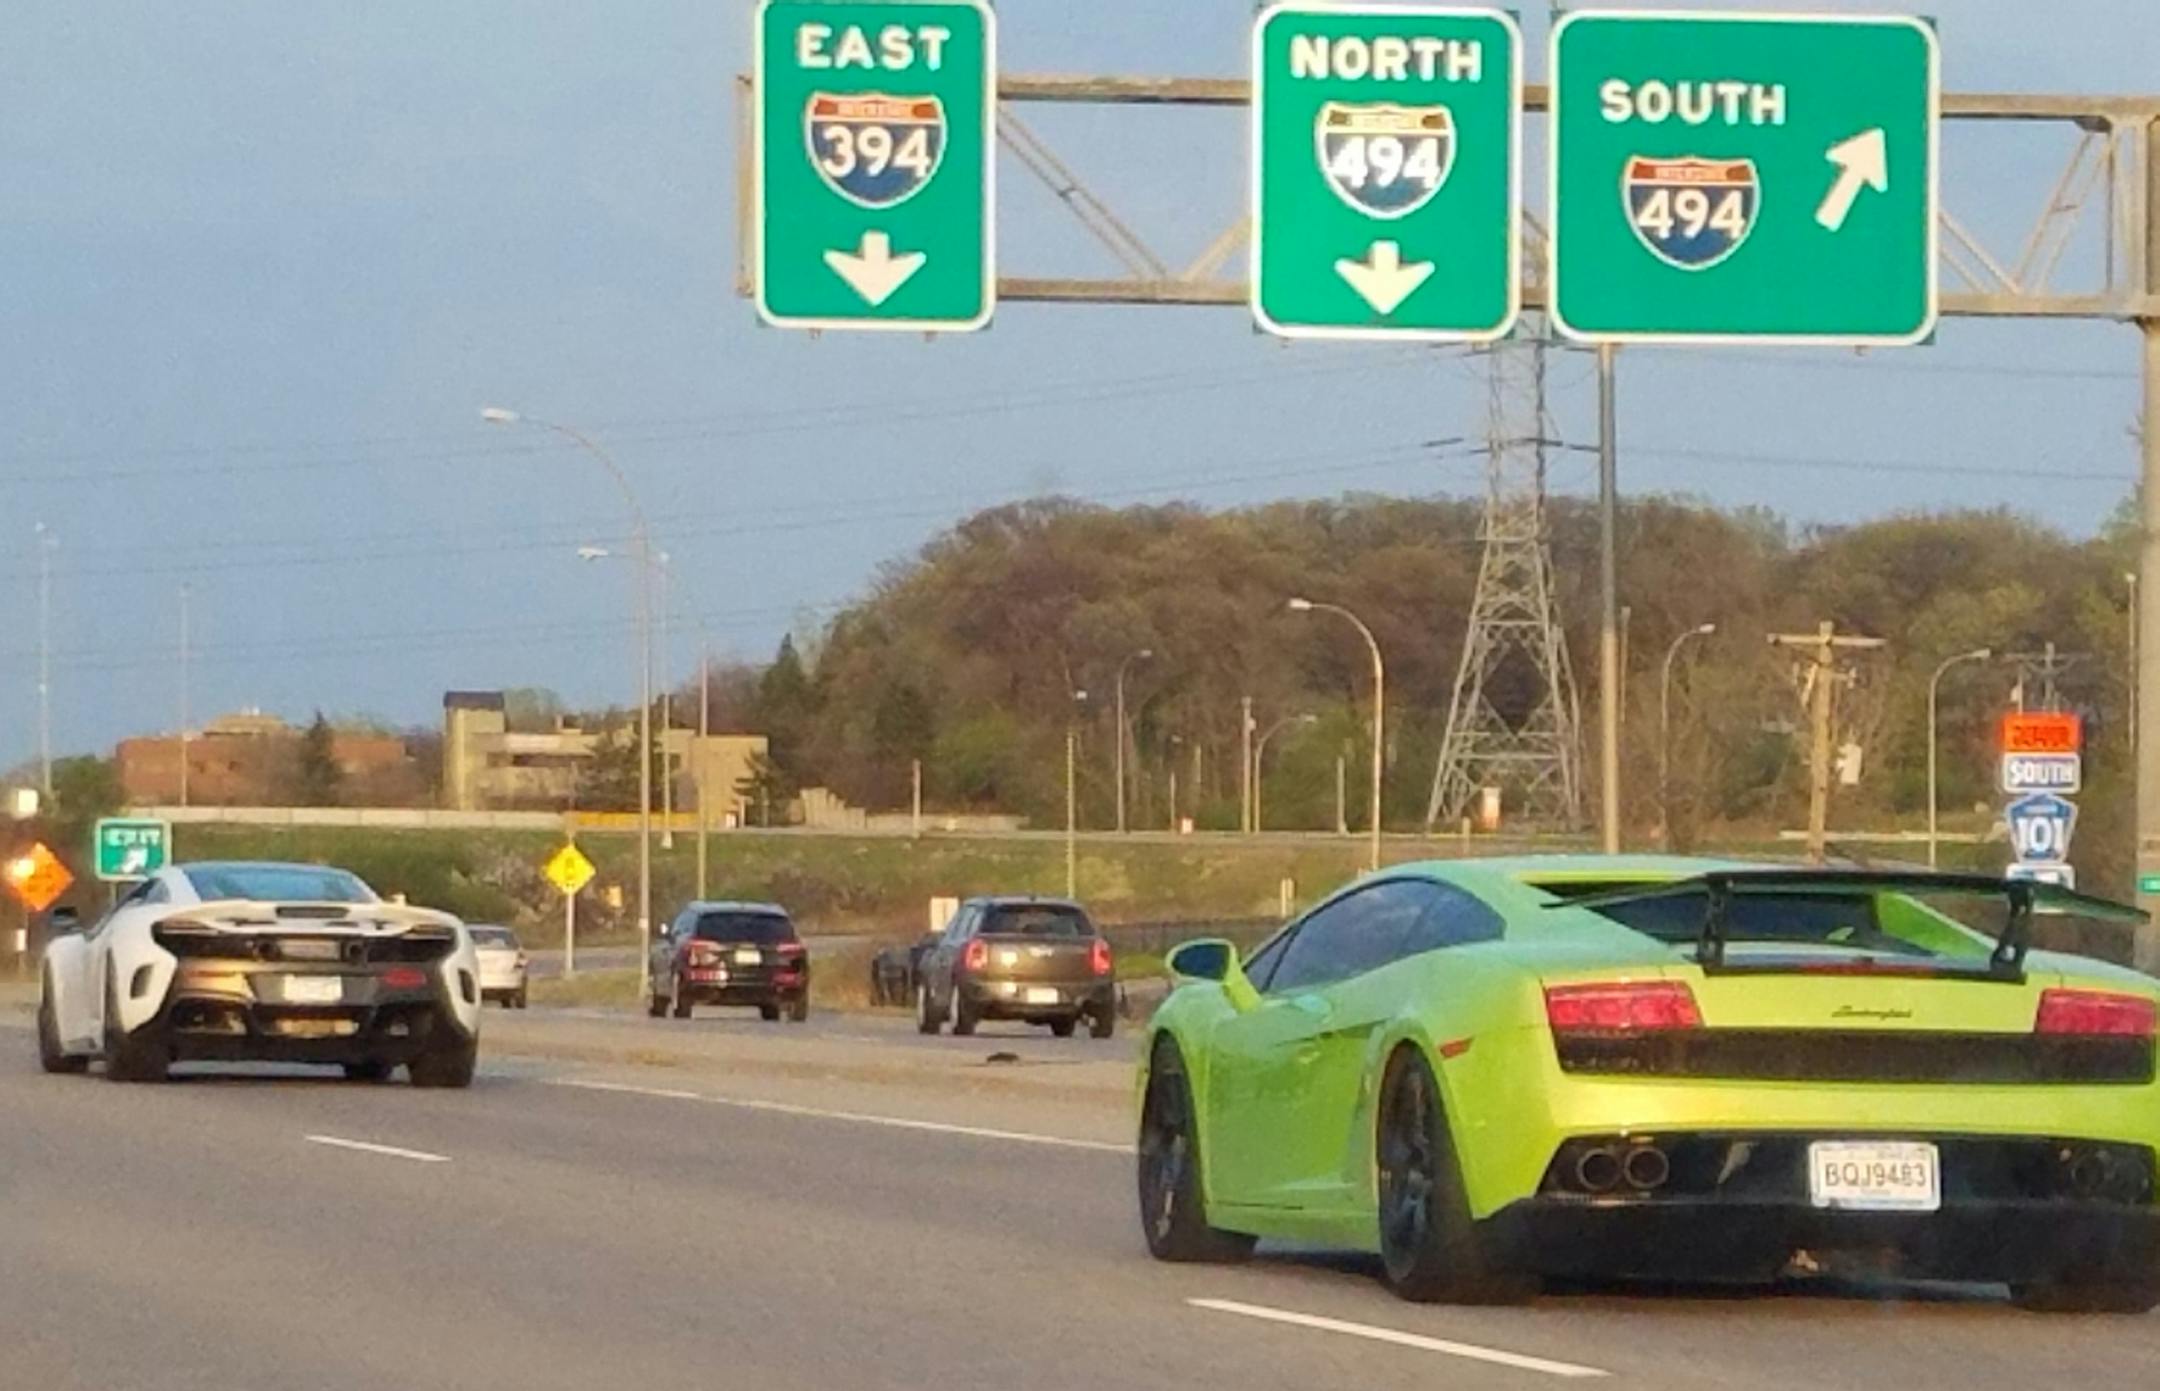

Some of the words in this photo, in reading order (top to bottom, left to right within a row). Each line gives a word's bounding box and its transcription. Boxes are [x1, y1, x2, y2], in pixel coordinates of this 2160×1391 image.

[798, 23, 951, 71] EAST
[1290, 34, 1482, 82] NORTH
[1599, 78, 1786, 125] SOUTH
[822, 125, 931, 178] 394
[1332, 136, 1441, 189] 494
[1638, 188, 1745, 240] 494
[2010, 761, 2073, 785] SOUTH
[2017, 817, 2064, 853] 101
